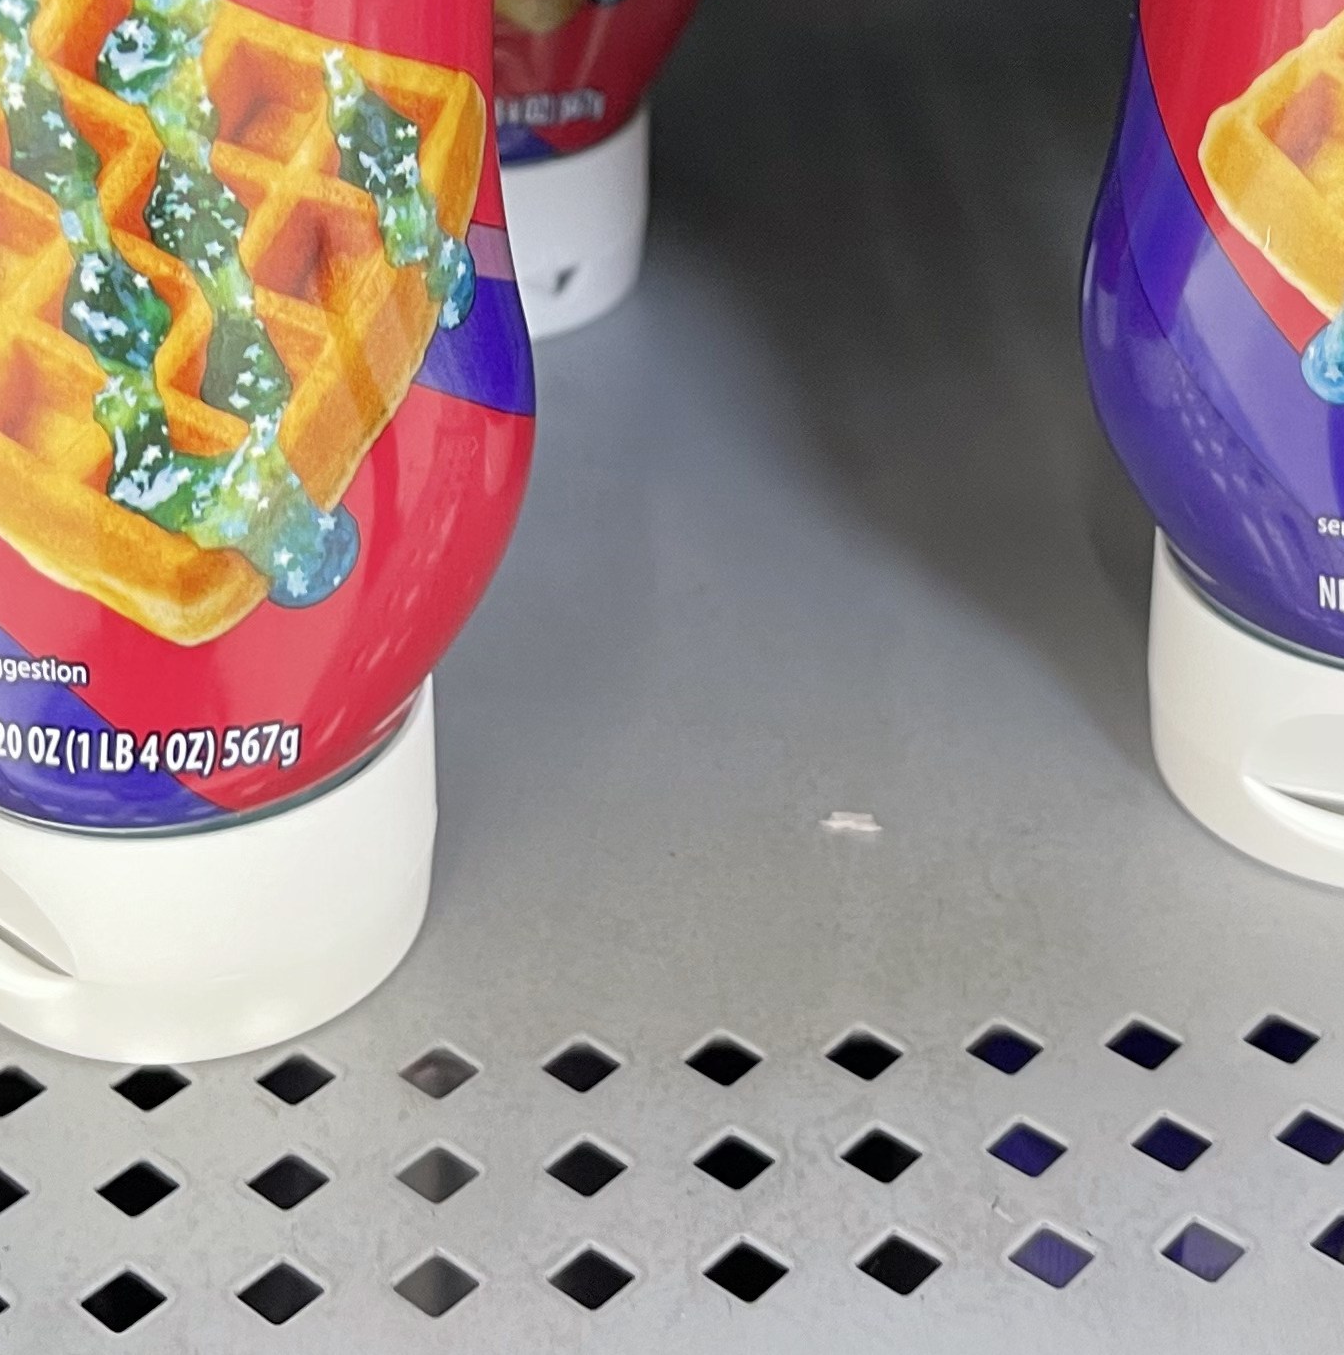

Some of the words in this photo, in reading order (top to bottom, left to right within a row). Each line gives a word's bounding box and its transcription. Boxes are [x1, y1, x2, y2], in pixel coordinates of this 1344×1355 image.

[29, 727, 60, 766] OZ
[66, 733, 90, 774] (1
[100, 735, 133, 771] LB
[139, 736, 159, 772] 4
[166, 733, 215, 775] OZ)
[223, 723, 301, 768] 567g
